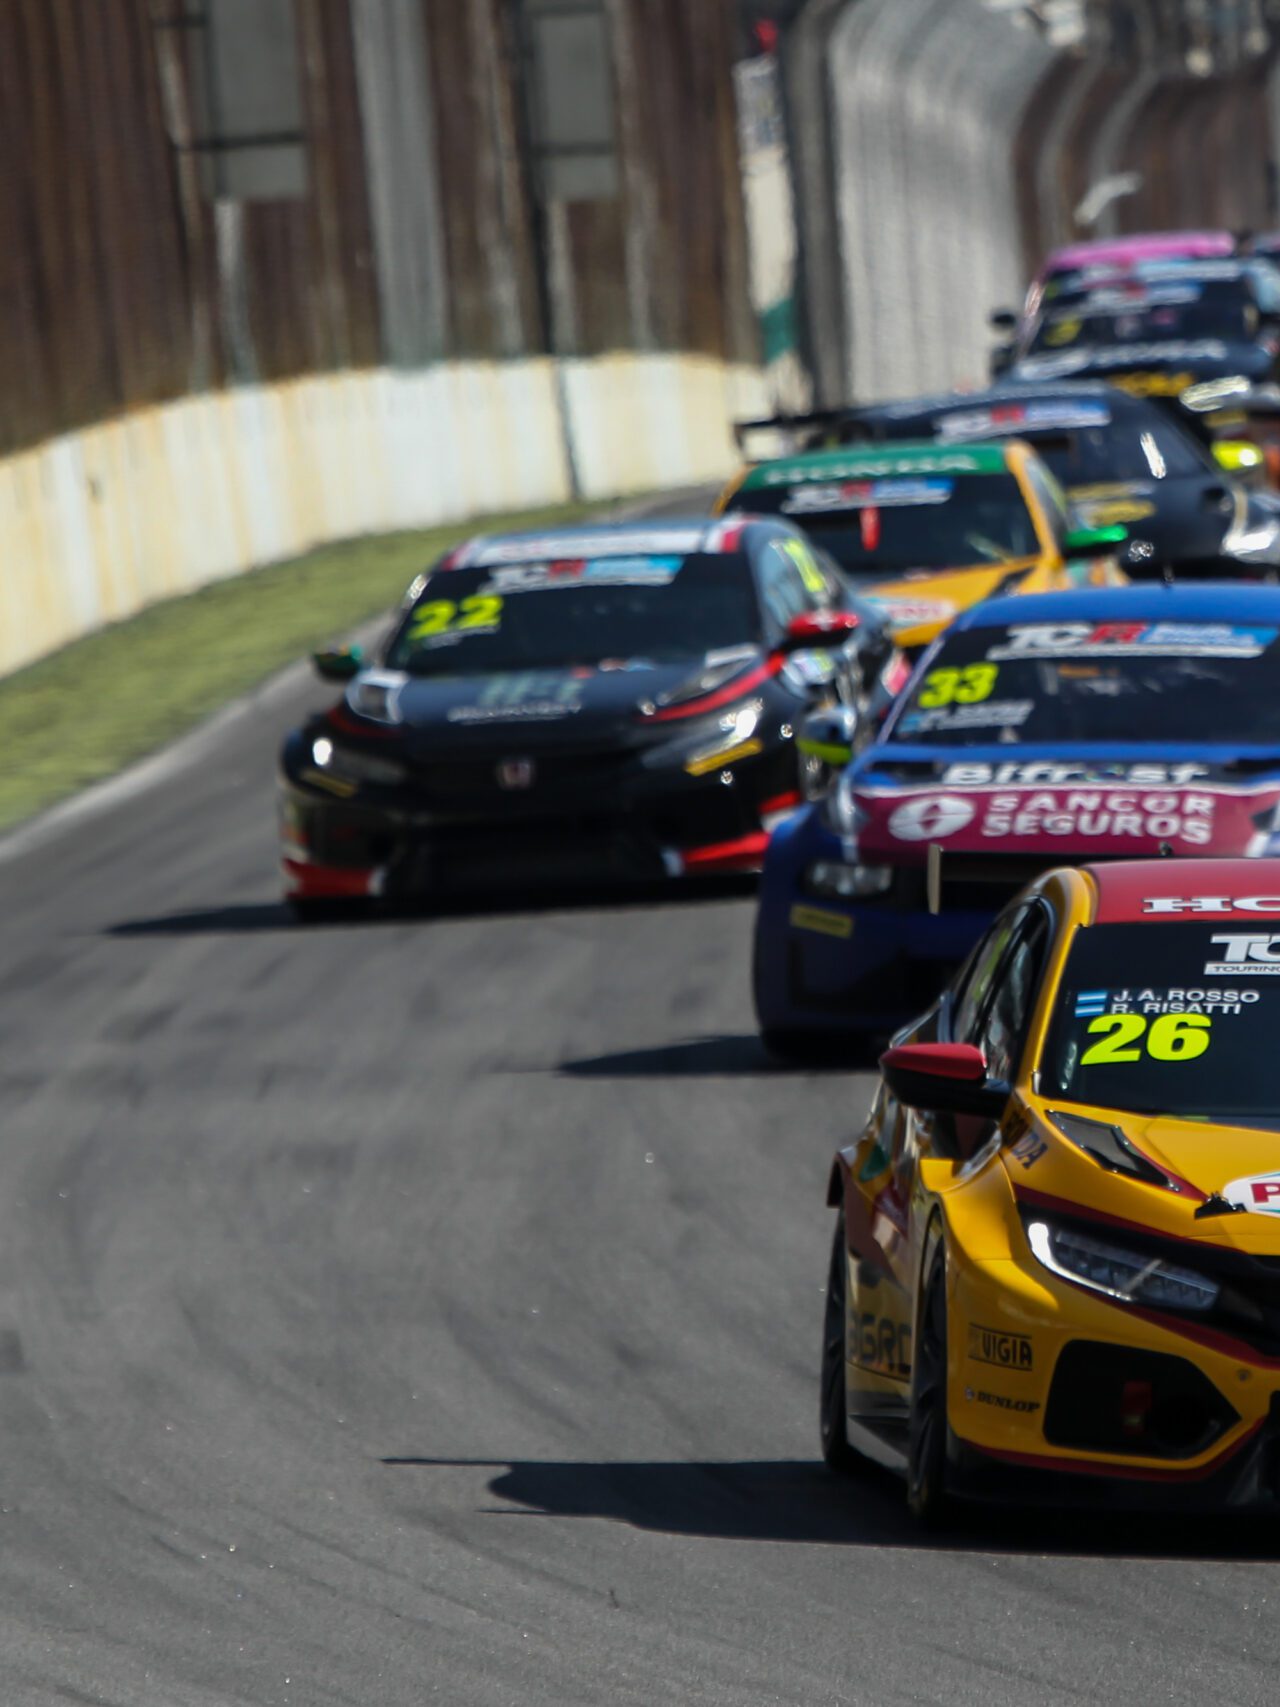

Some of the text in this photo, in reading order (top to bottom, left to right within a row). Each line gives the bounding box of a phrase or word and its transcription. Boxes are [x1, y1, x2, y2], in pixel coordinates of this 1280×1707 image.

[407, 594, 504, 640] 22
[1008, 623, 1147, 648] TCR
[919, 663, 998, 707] 33
[989, 794, 1215, 816] SANCOR
[981, 814, 1212, 844] SEGUROS
[1111, 1003, 1241, 1014] R. RISATTI
[1113, 990, 1260, 1003] J. A. ROSSO
[1080, 1013, 1212, 1065] 26
[977, 1391, 1040, 1413] DUNLOP
